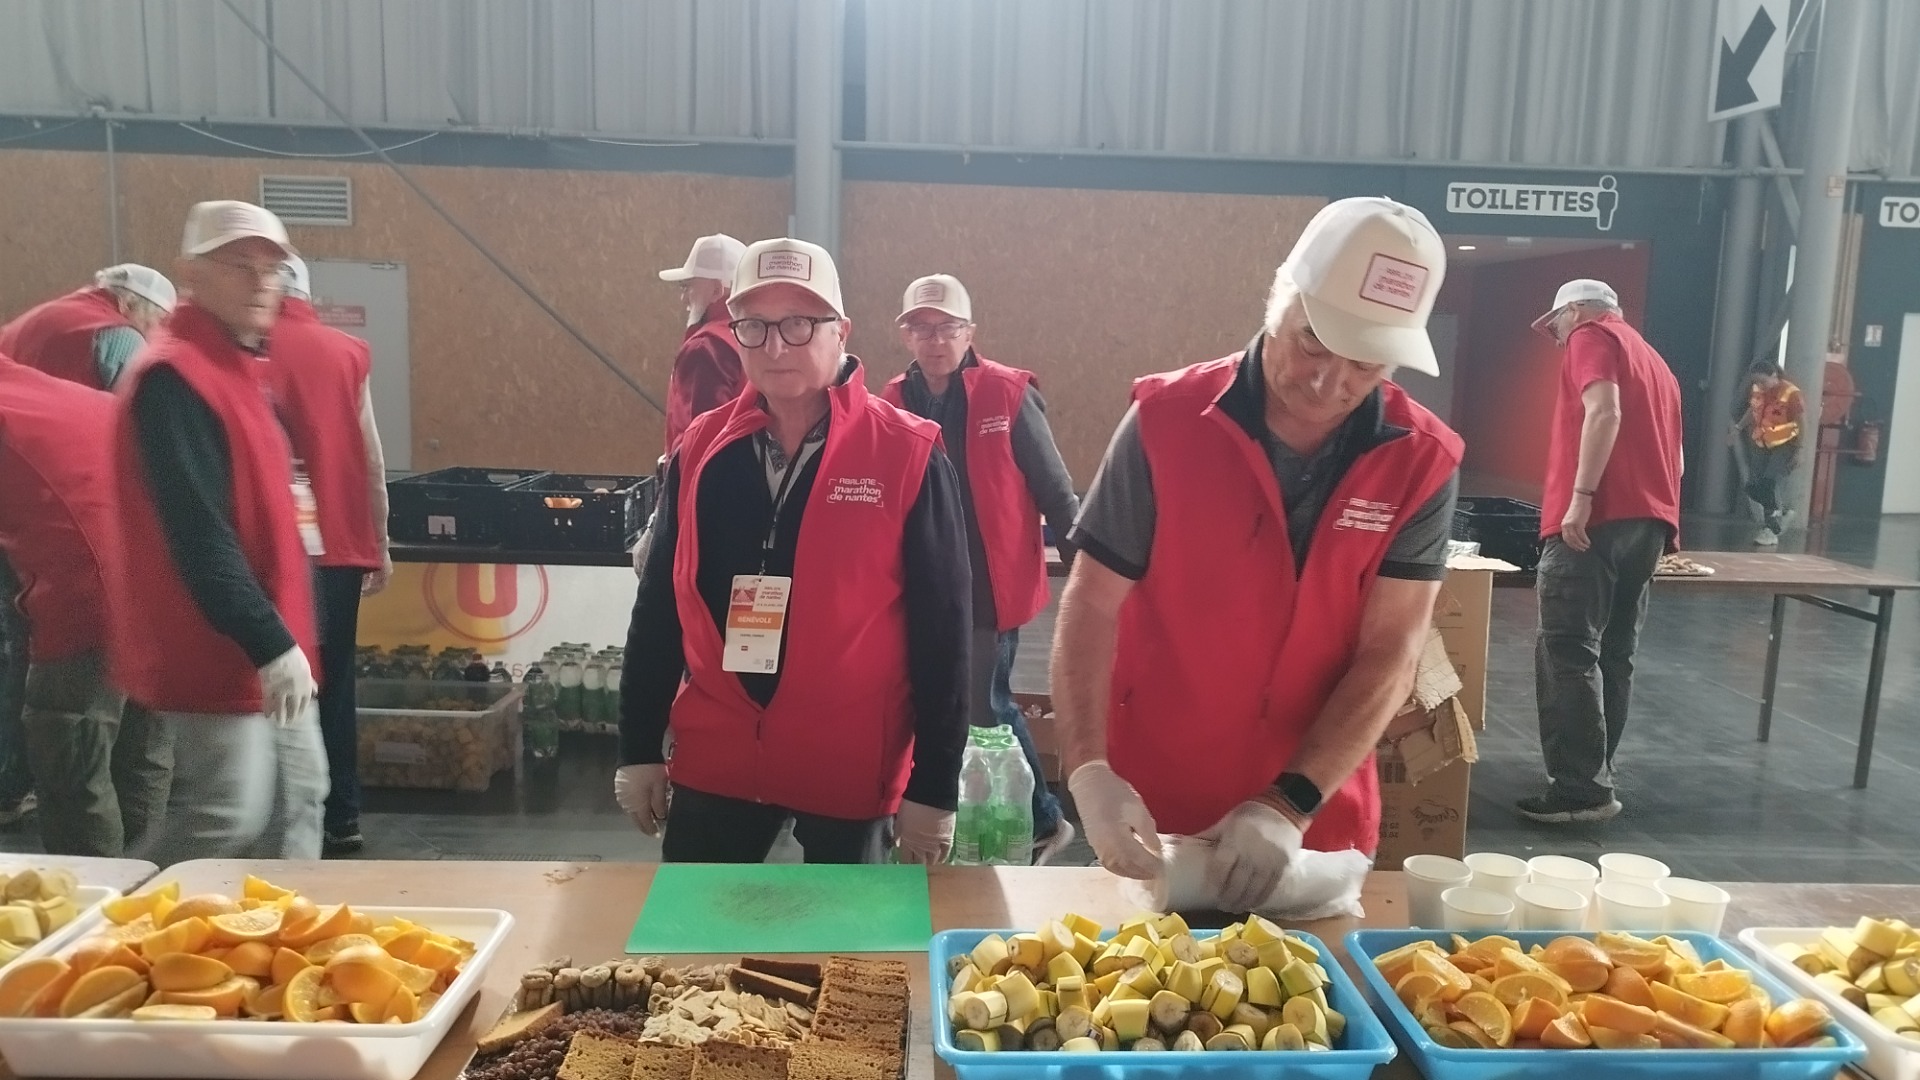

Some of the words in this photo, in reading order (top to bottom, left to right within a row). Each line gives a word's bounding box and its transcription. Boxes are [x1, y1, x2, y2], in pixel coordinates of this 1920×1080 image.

[1451, 187, 1594, 213] TOILETTES
[1884, 201, 1920, 223] TO
[766, 263, 776, 271] de
[776, 264, 801, 272] nantes
[768, 260, 803, 269] marathon
[839, 477, 877, 485] ABALONE
[829, 491, 843, 501] de
[844, 493, 878, 503] nantes
[834, 485, 882, 498] marathon
[457, 563, 517, 618] U
